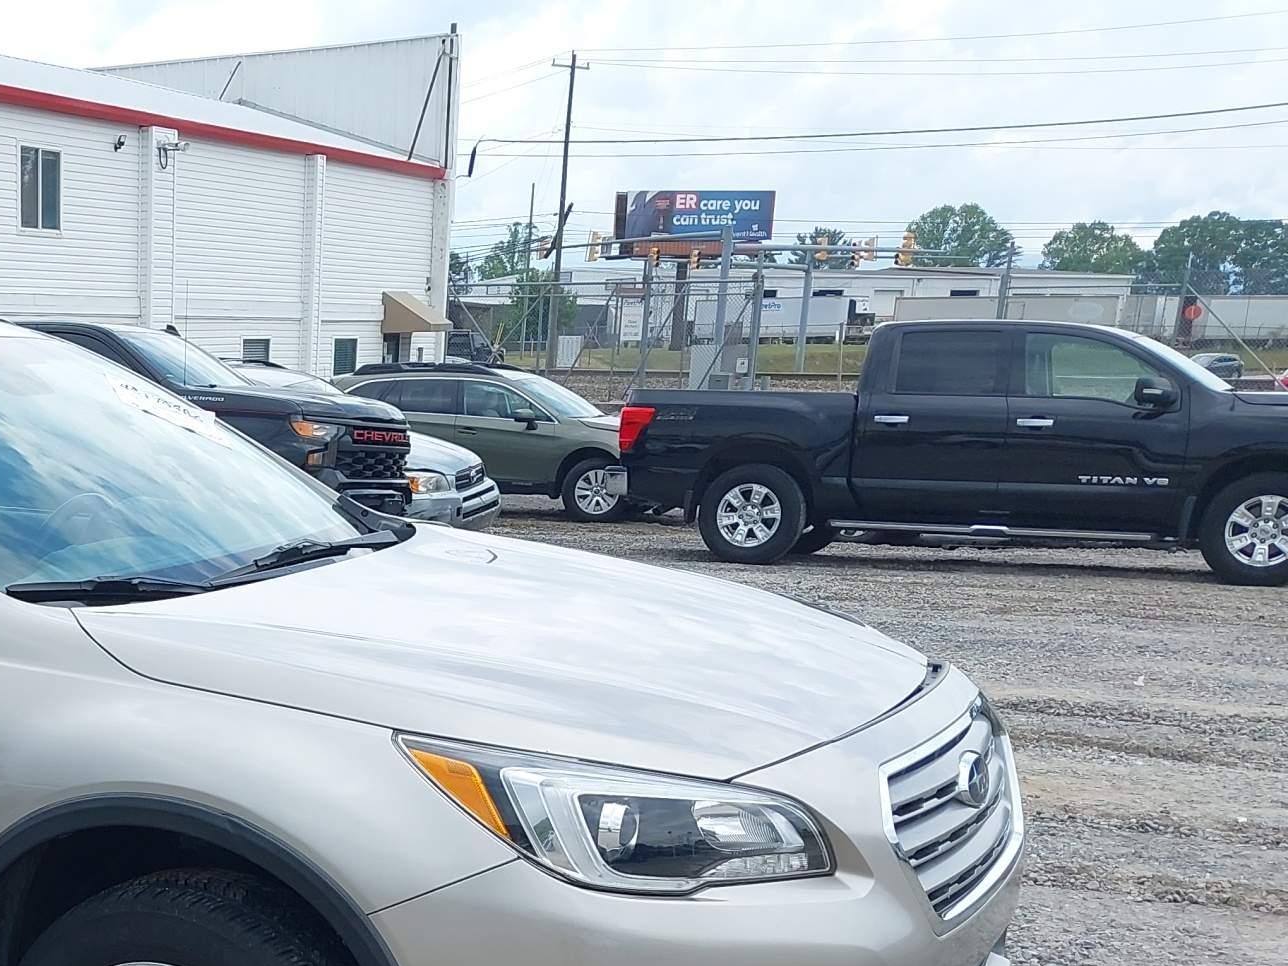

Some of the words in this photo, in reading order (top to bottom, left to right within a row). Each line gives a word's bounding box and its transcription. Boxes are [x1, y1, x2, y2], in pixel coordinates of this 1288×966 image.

[676, 194, 697, 209] ER
[700, 199, 731, 211] care
[734, 200, 760, 213] you
[672, 214, 699, 225] can
[701, 212, 737, 225] trust.
[1078, 475, 1138, 485] TITAN
